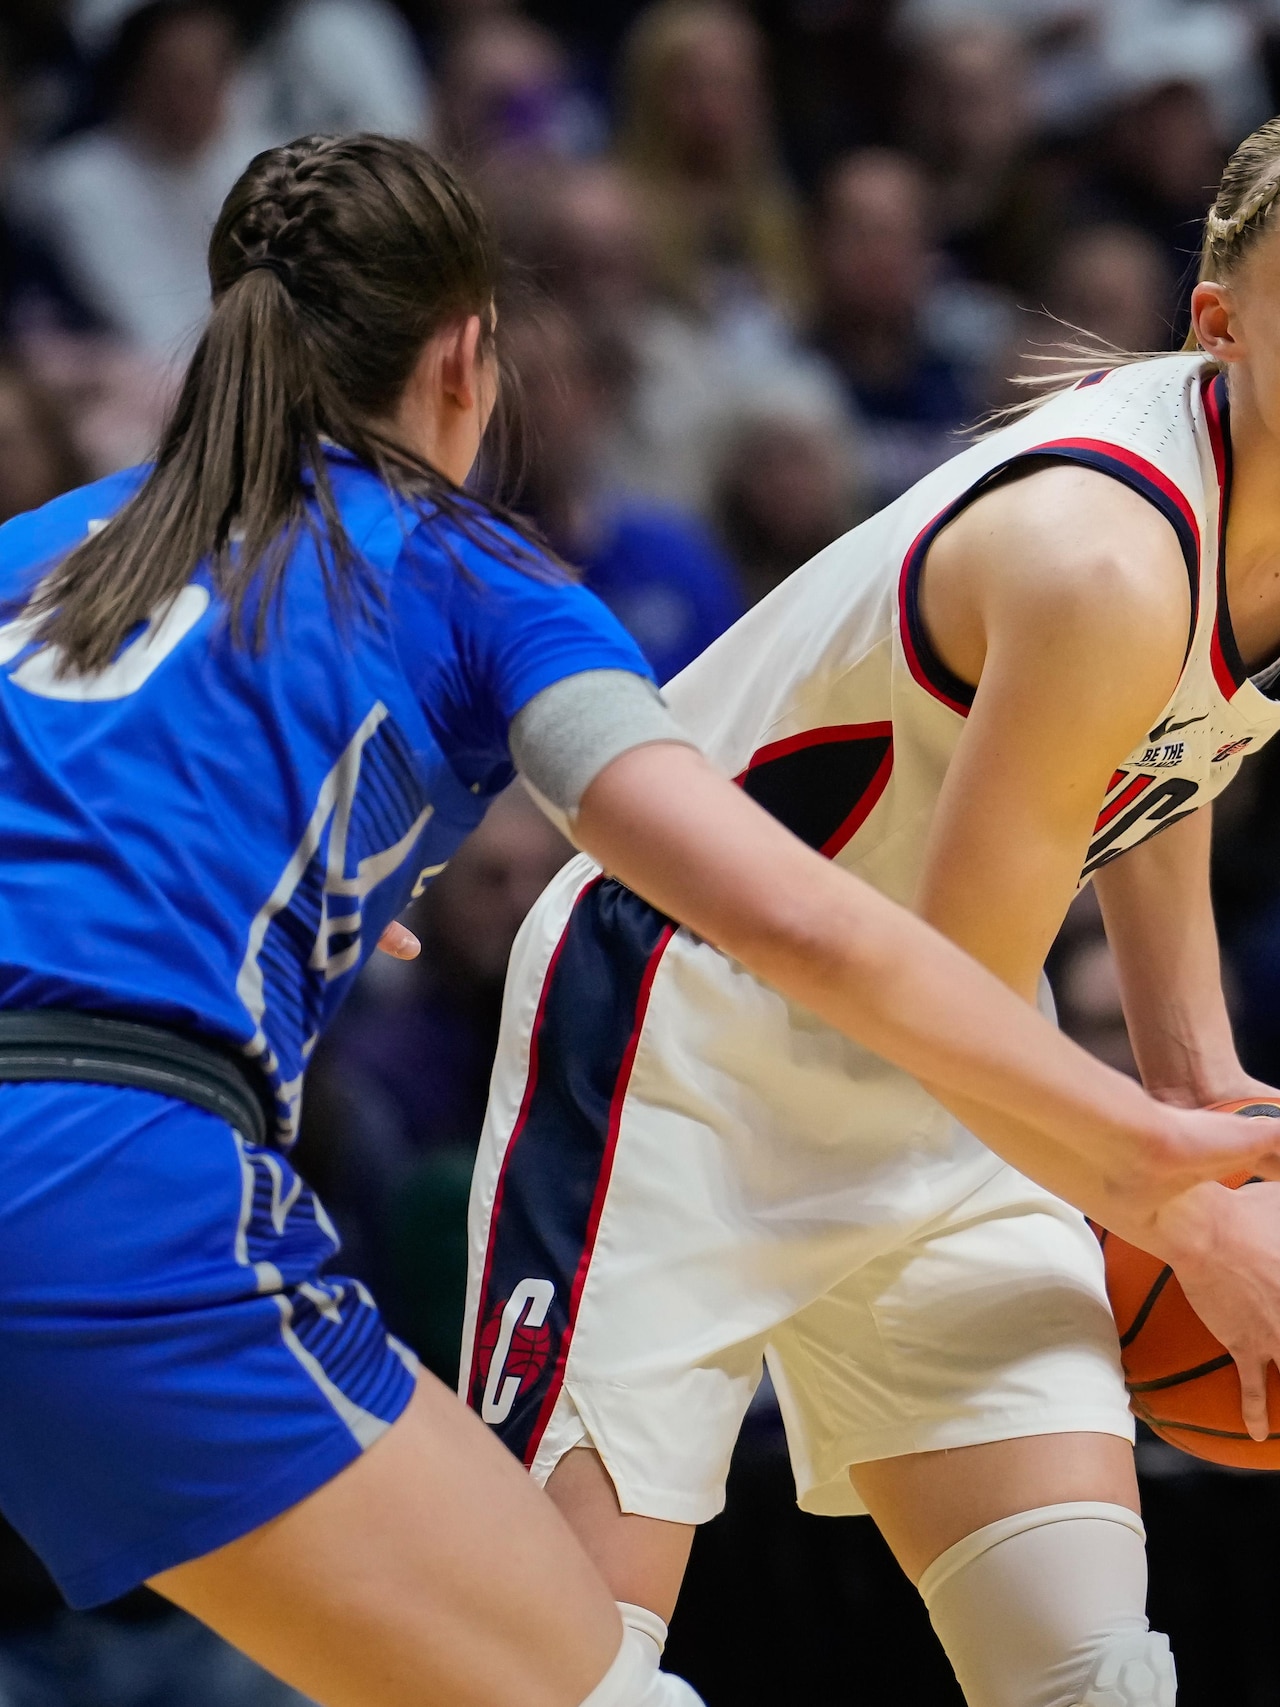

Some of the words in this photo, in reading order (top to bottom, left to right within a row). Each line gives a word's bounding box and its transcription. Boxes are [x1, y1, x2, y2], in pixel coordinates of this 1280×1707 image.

[1140, 747, 1161, 762] BE
[1162, 742, 1184, 761] THE
[481, 1277, 555, 1425] C
